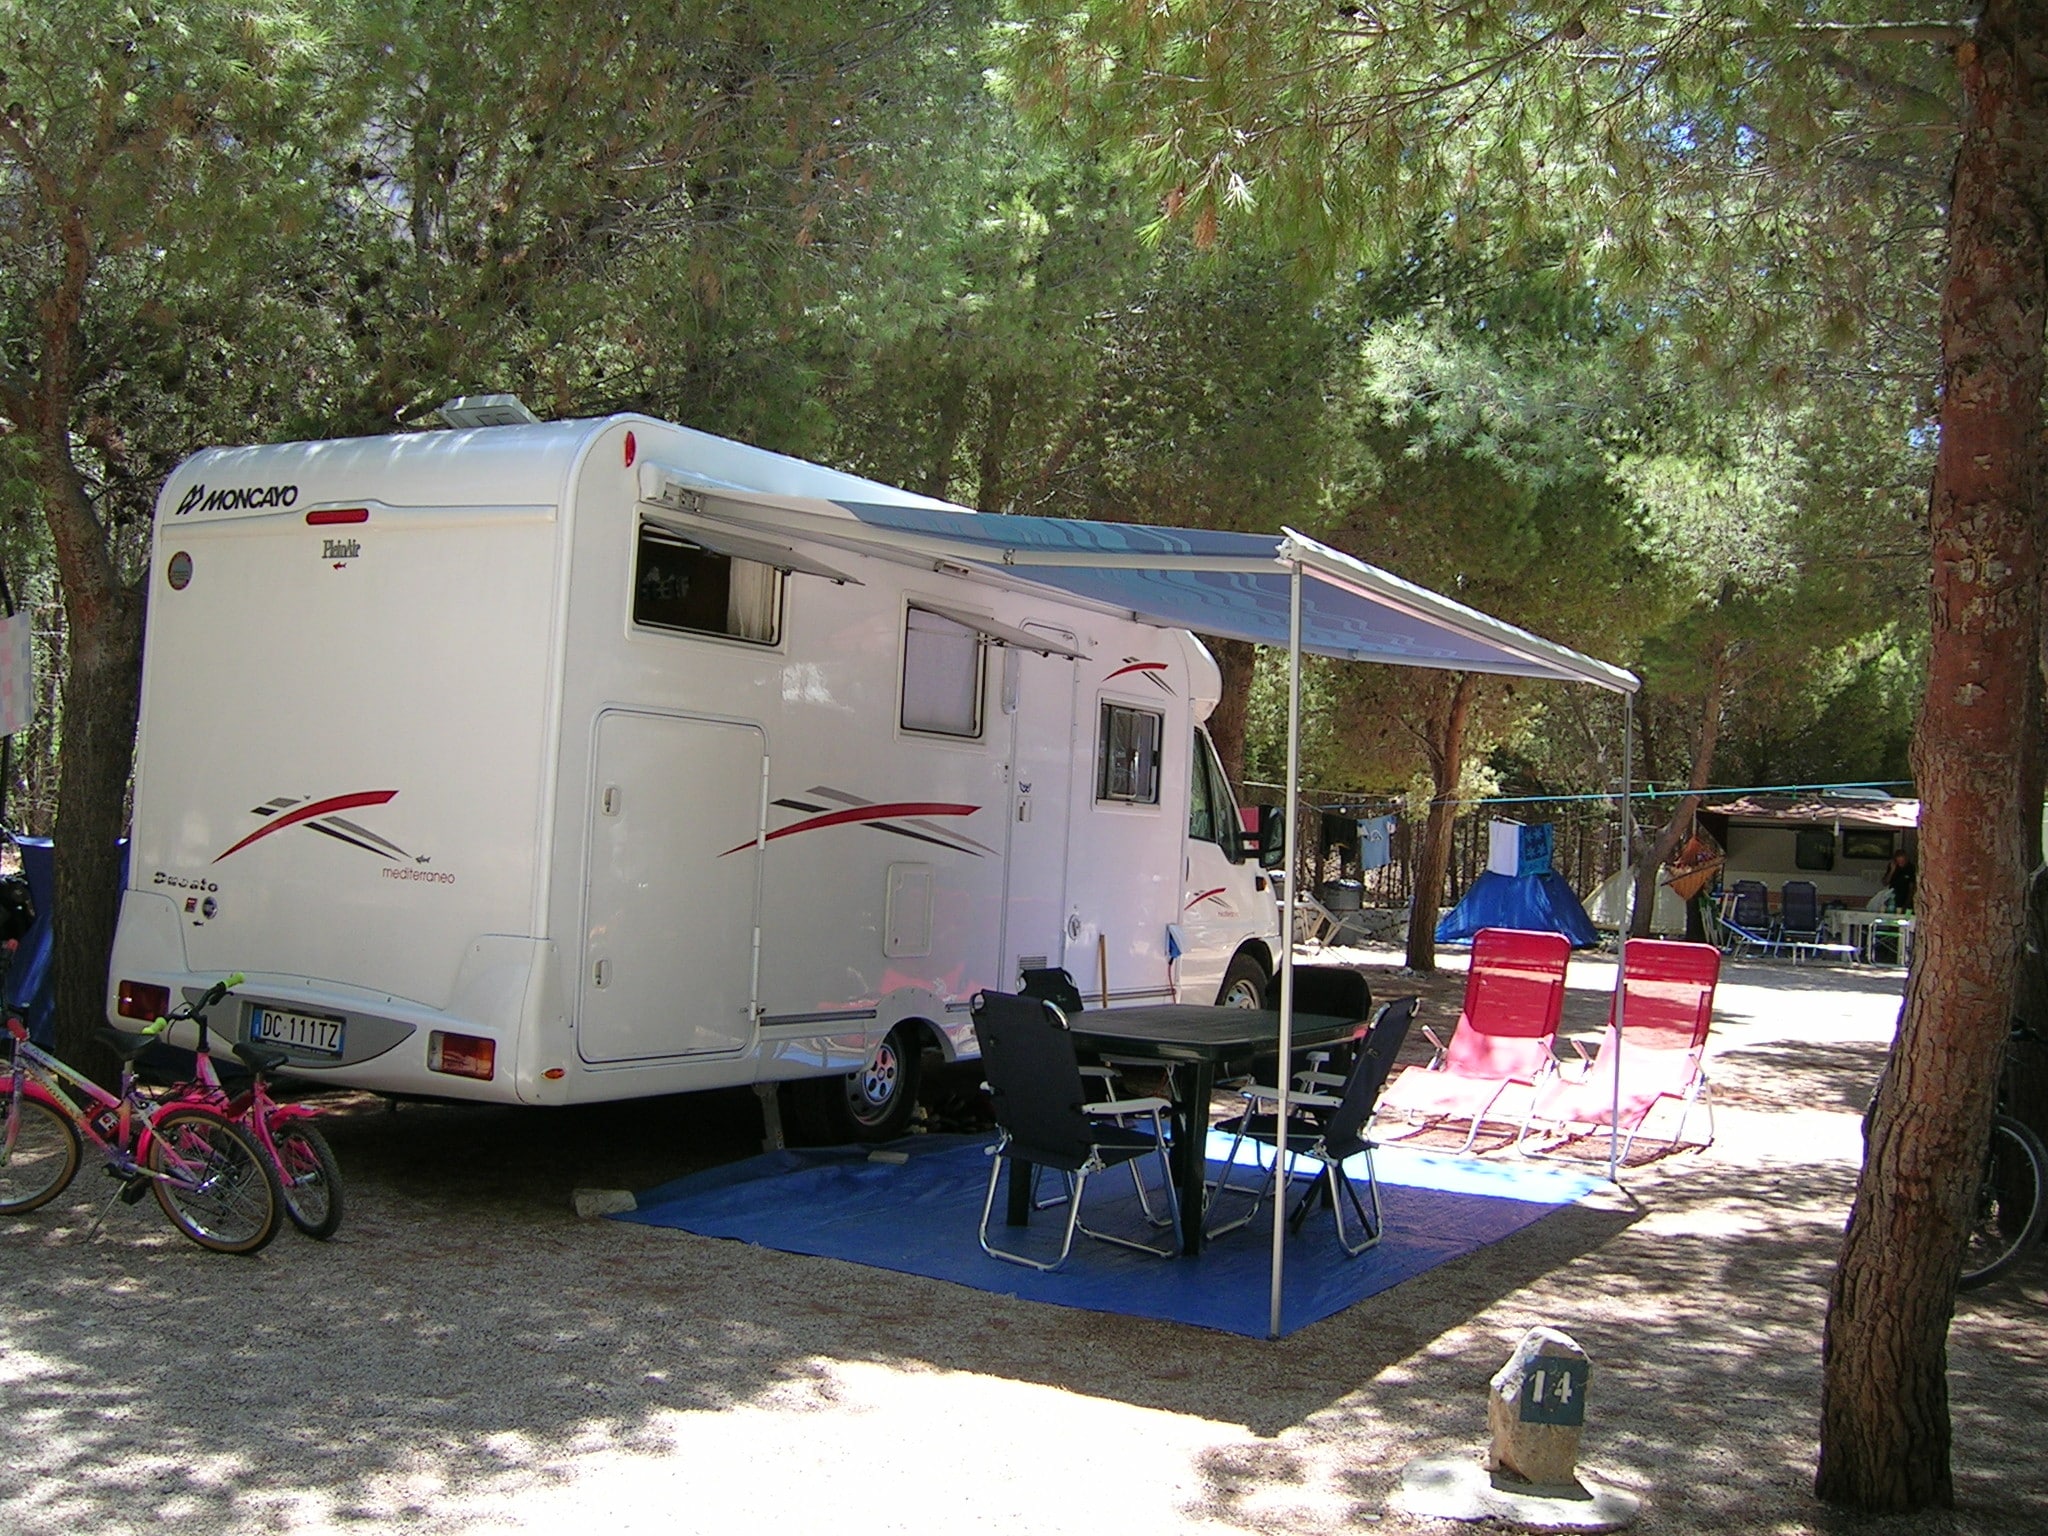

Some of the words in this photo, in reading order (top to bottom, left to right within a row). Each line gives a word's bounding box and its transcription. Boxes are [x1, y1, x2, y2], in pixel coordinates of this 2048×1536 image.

[199, 485, 298, 511] MONCAYO
[382, 867, 455, 884] mediterraneo
[1529, 1369, 1573, 1404] 14
